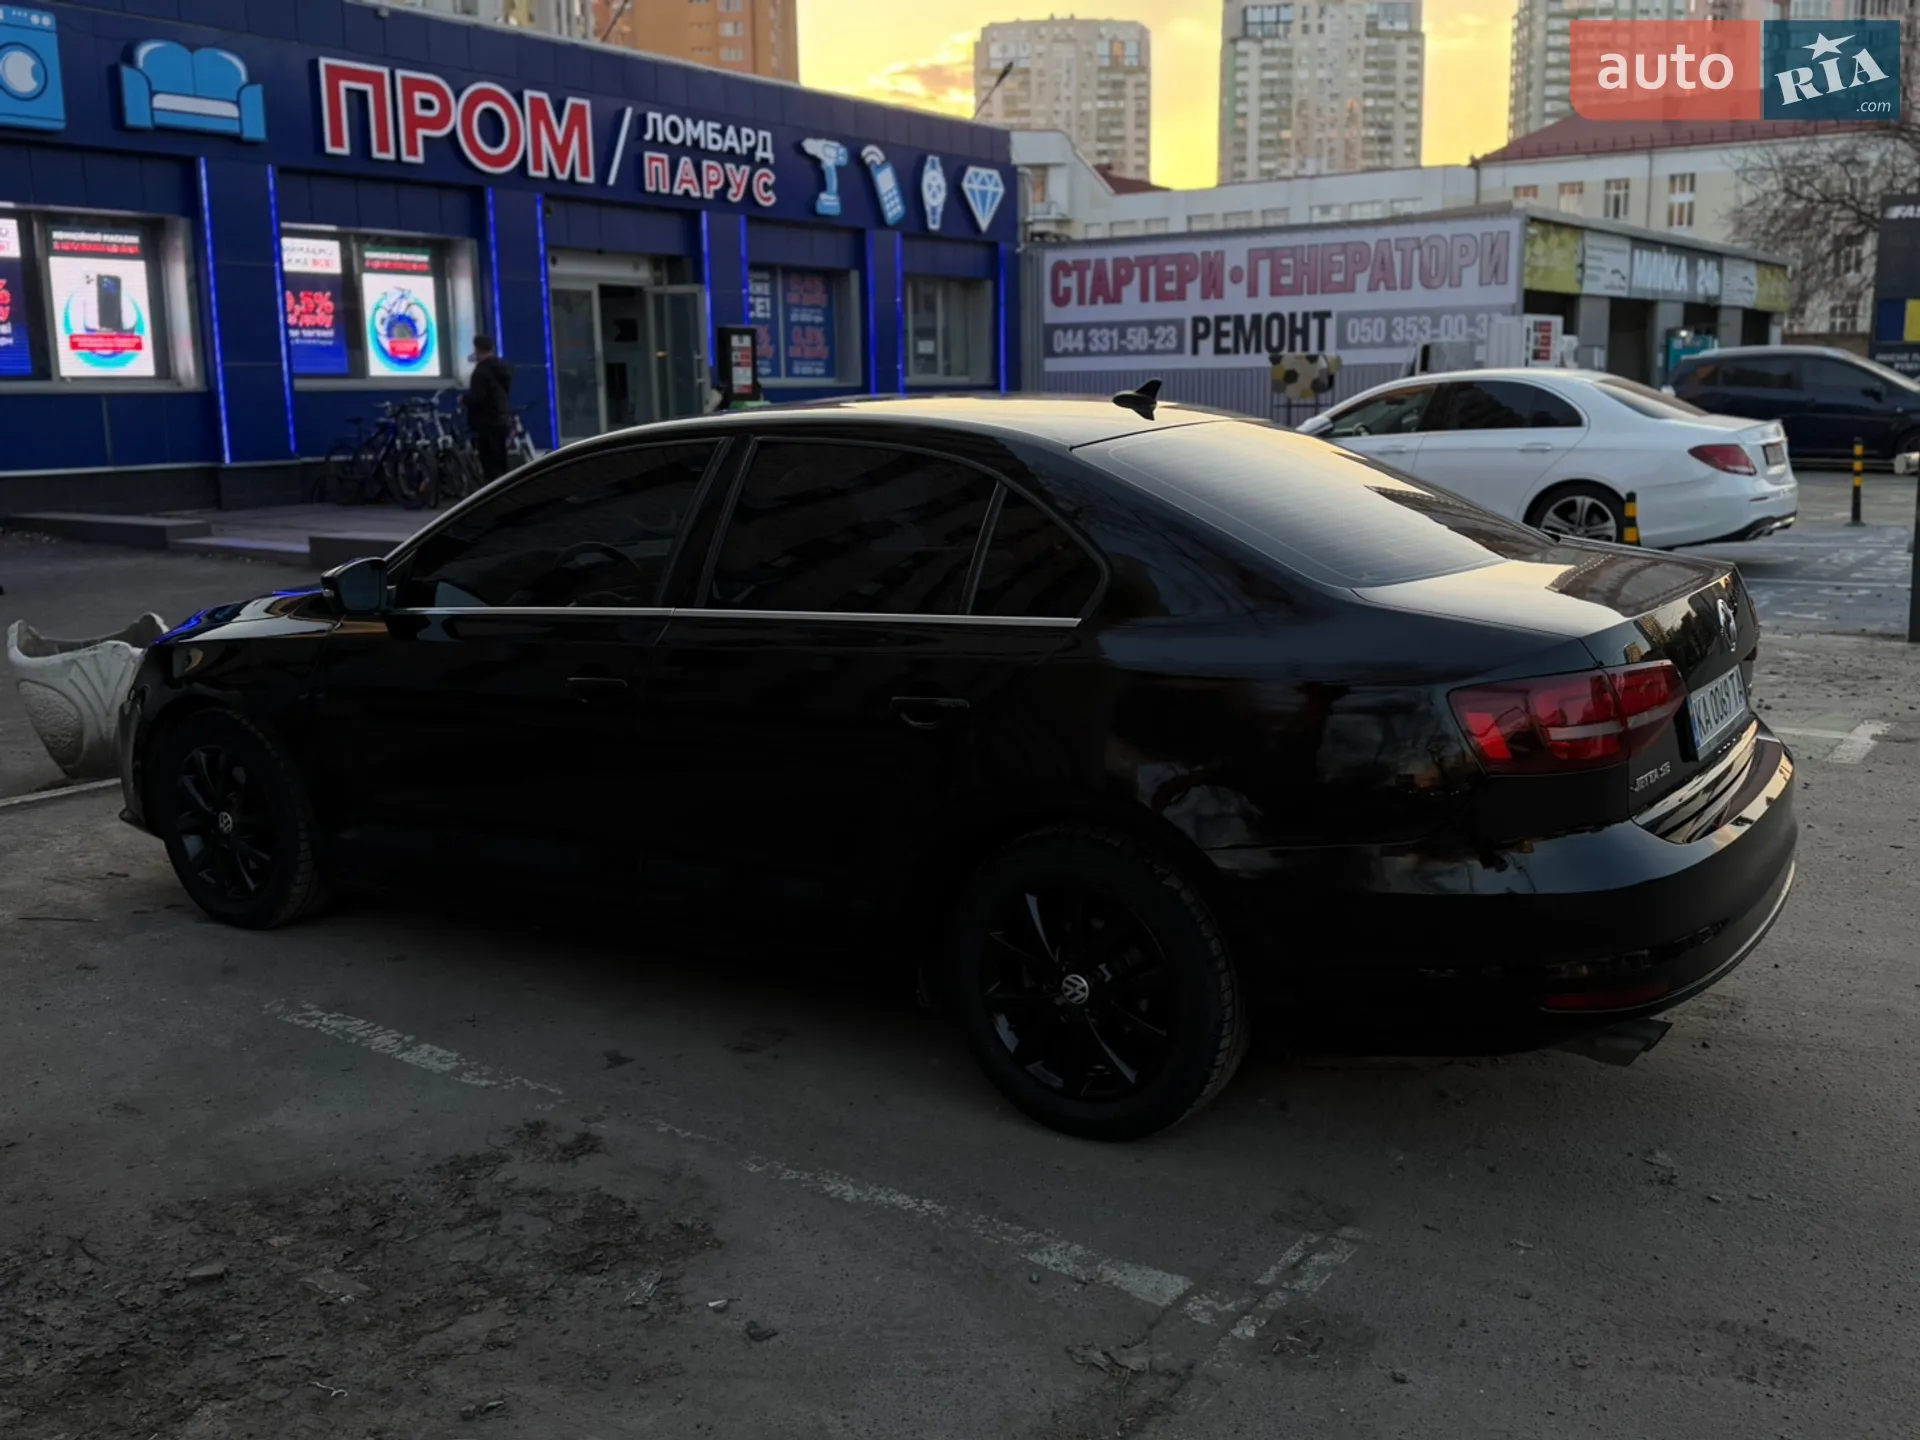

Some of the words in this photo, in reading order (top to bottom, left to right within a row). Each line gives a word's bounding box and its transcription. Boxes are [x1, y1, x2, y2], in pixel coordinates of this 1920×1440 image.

[318, 56, 595, 184] ПРОМ
[643, 111, 775, 162] ЛОМБАРД
[643, 151, 776, 207] ПАРУС
[1050, 250, 1226, 309] СТАРТЕРИ
[1247, 231, 1511, 299] ГЕНЕРАТОРИ
[1052, 327, 1085, 354] 044
[1088, 325, 1178, 352] 331-50-23
[1191, 310, 1332, 356] РЕМОНТ
[1346, 317, 1386, 344] 050
[1391, 312, 1488, 342] 353-00-3
[1692, 694, 1713, 740] KA
[1629, 767, 1660, 793] JETTA
